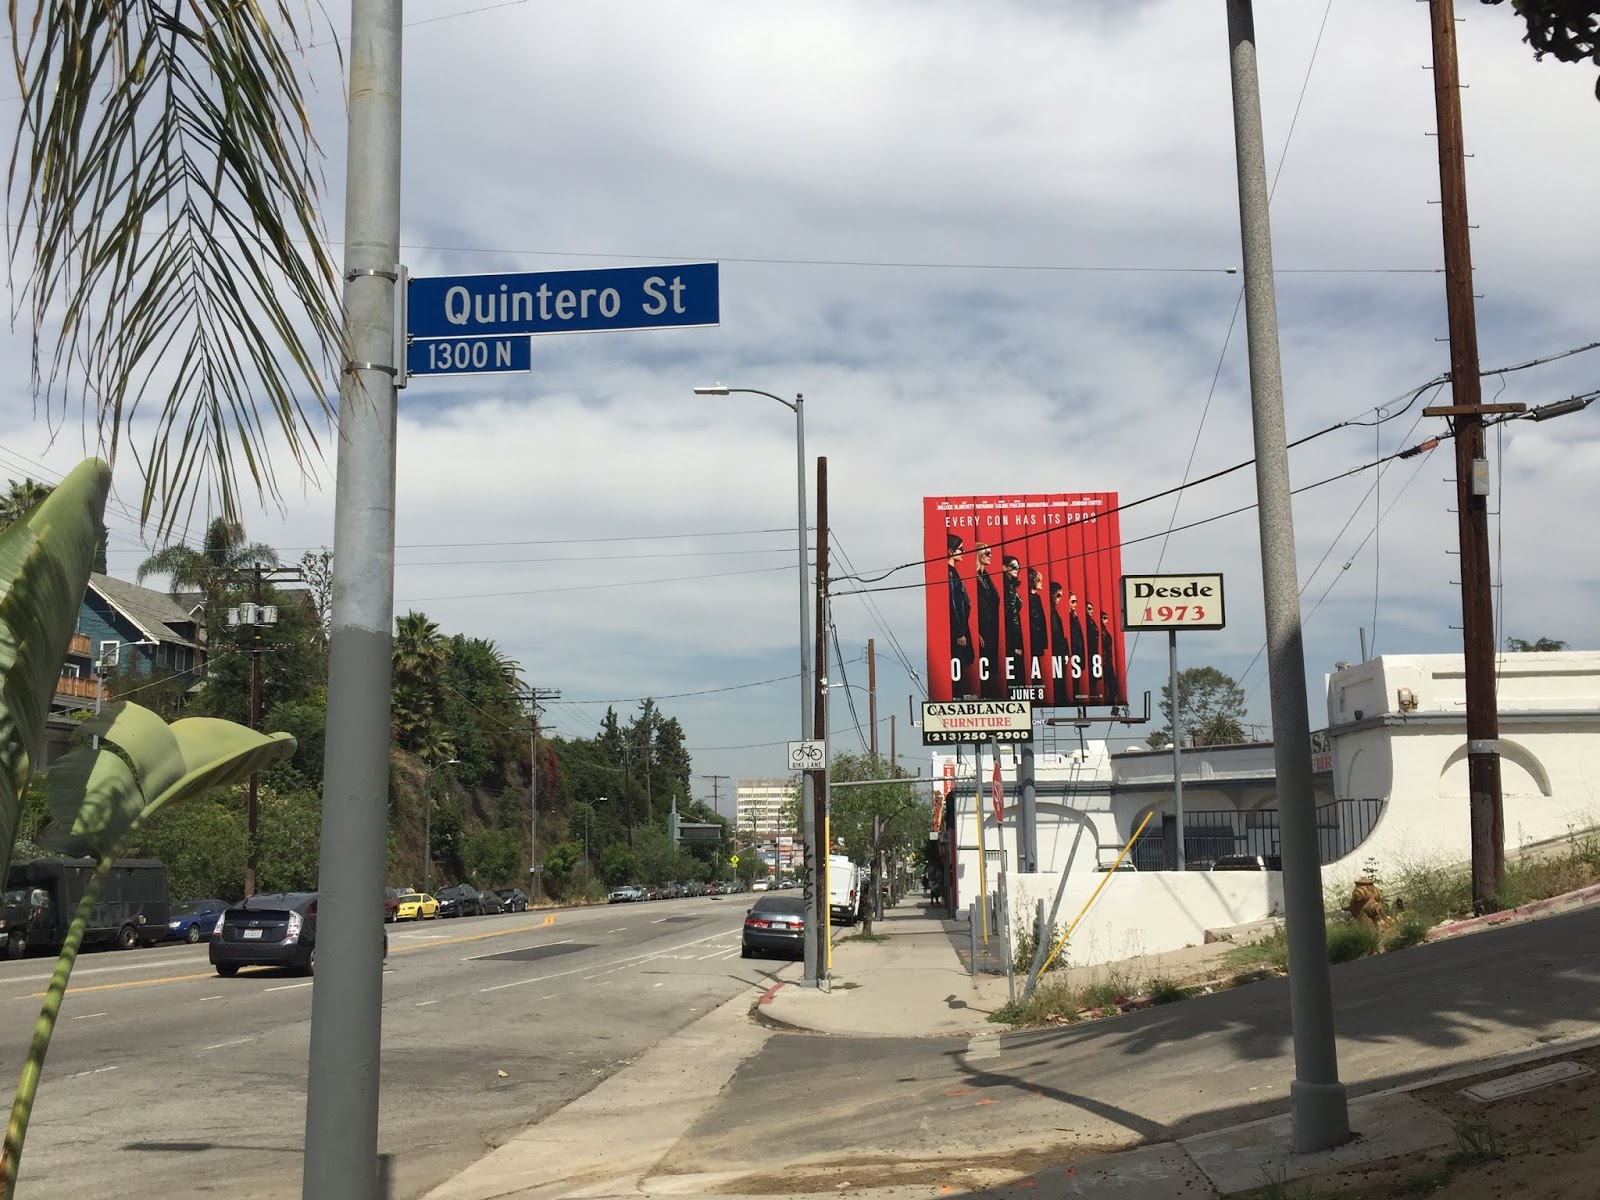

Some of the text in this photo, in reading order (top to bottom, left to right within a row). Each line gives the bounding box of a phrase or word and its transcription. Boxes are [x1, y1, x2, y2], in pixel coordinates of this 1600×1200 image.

[444, 275, 687, 326] Quintero St
[428, 340, 512, 370] 1300 N
[945, 511, 1097, 528] EVERY CON HAS ITS PROS
[1133, 581, 1214, 599] Desde
[1143, 605, 1206, 622] 1973
[1092, 653, 1103, 678] 8
[1010, 688, 1044, 700] JUNE 8
[926, 702, 1027, 716] CASABLANCA
[942, 716, 1012, 728] FURNITURE
[792, 761, 805, 769] BIKE
